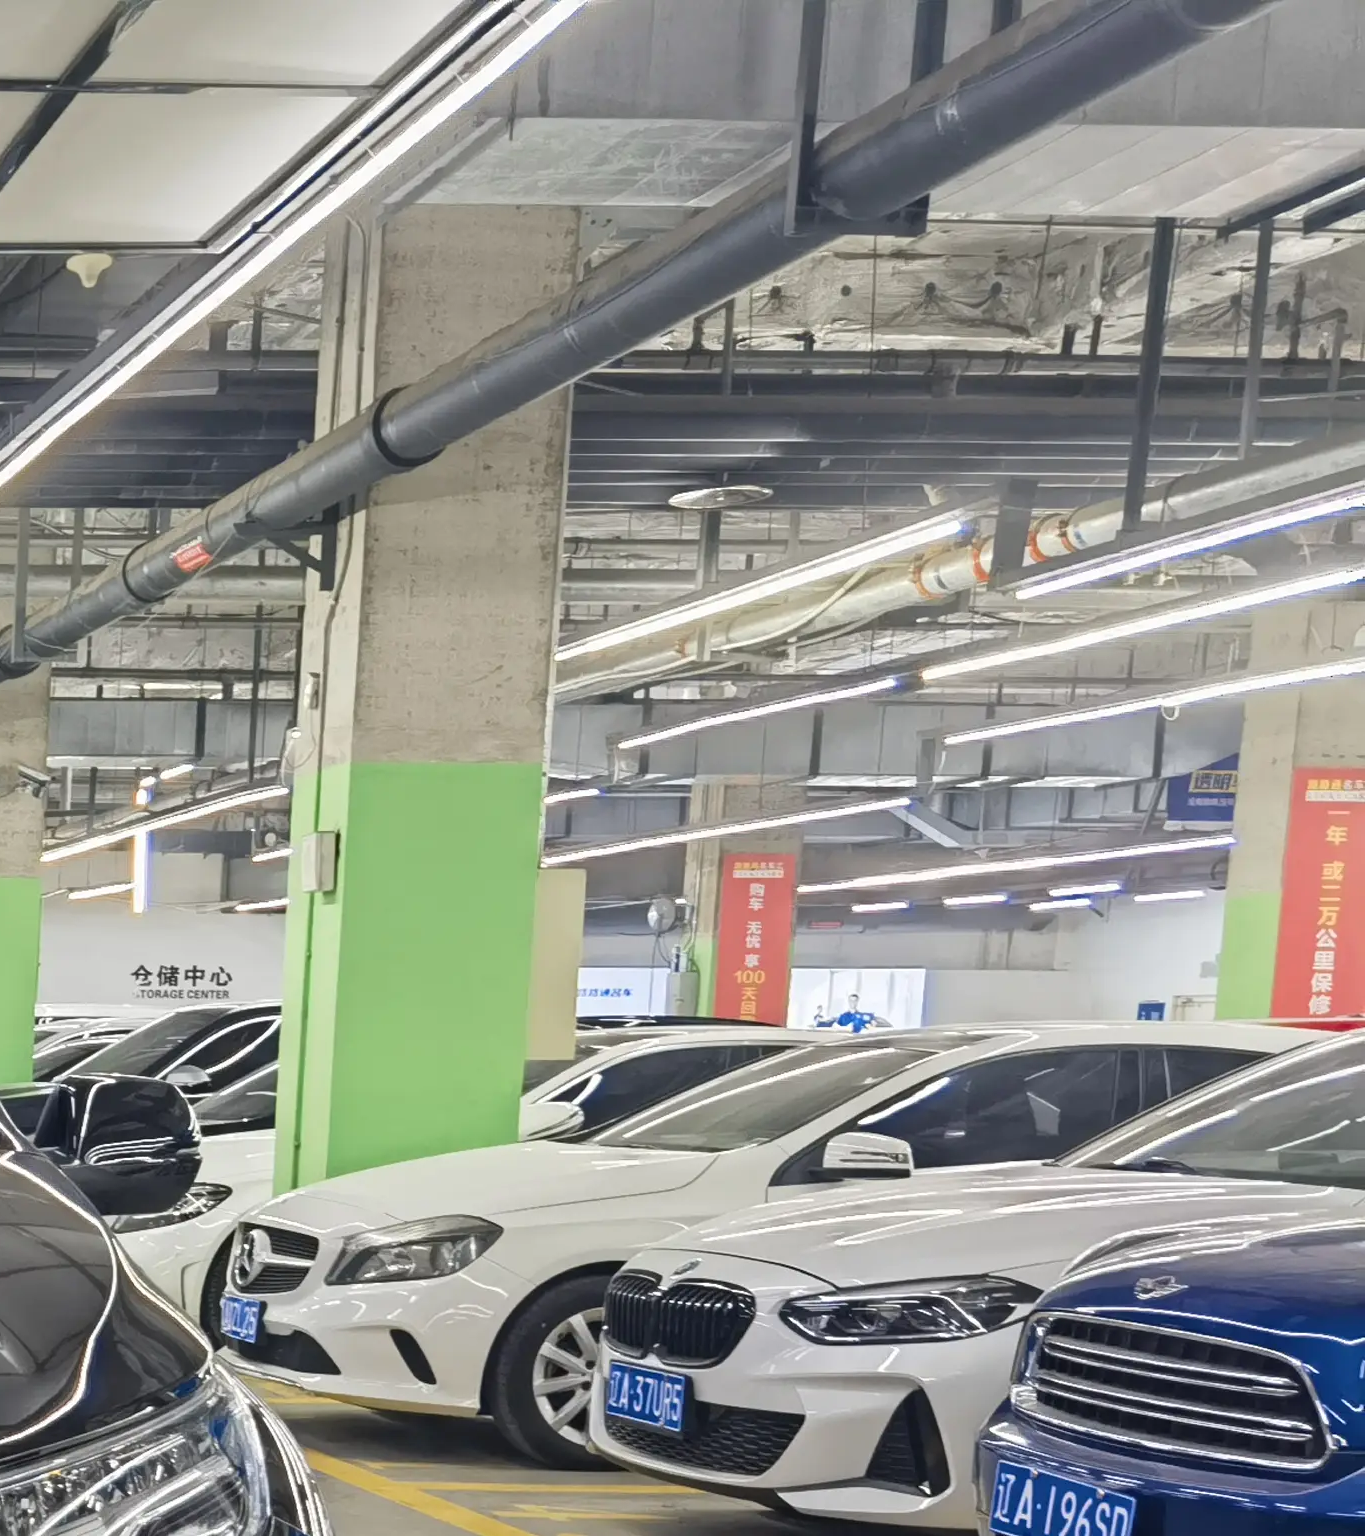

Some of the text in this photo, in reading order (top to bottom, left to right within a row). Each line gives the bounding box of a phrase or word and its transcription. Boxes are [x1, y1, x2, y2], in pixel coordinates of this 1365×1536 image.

[1195, 773, 1238, 790] 透明
[1308, 810, 1351, 1015] 一年 或二万公里保修
[130, 964, 233, 987] 仓储中心
[133, 989, 230, 1000] TORAGE CENTER
